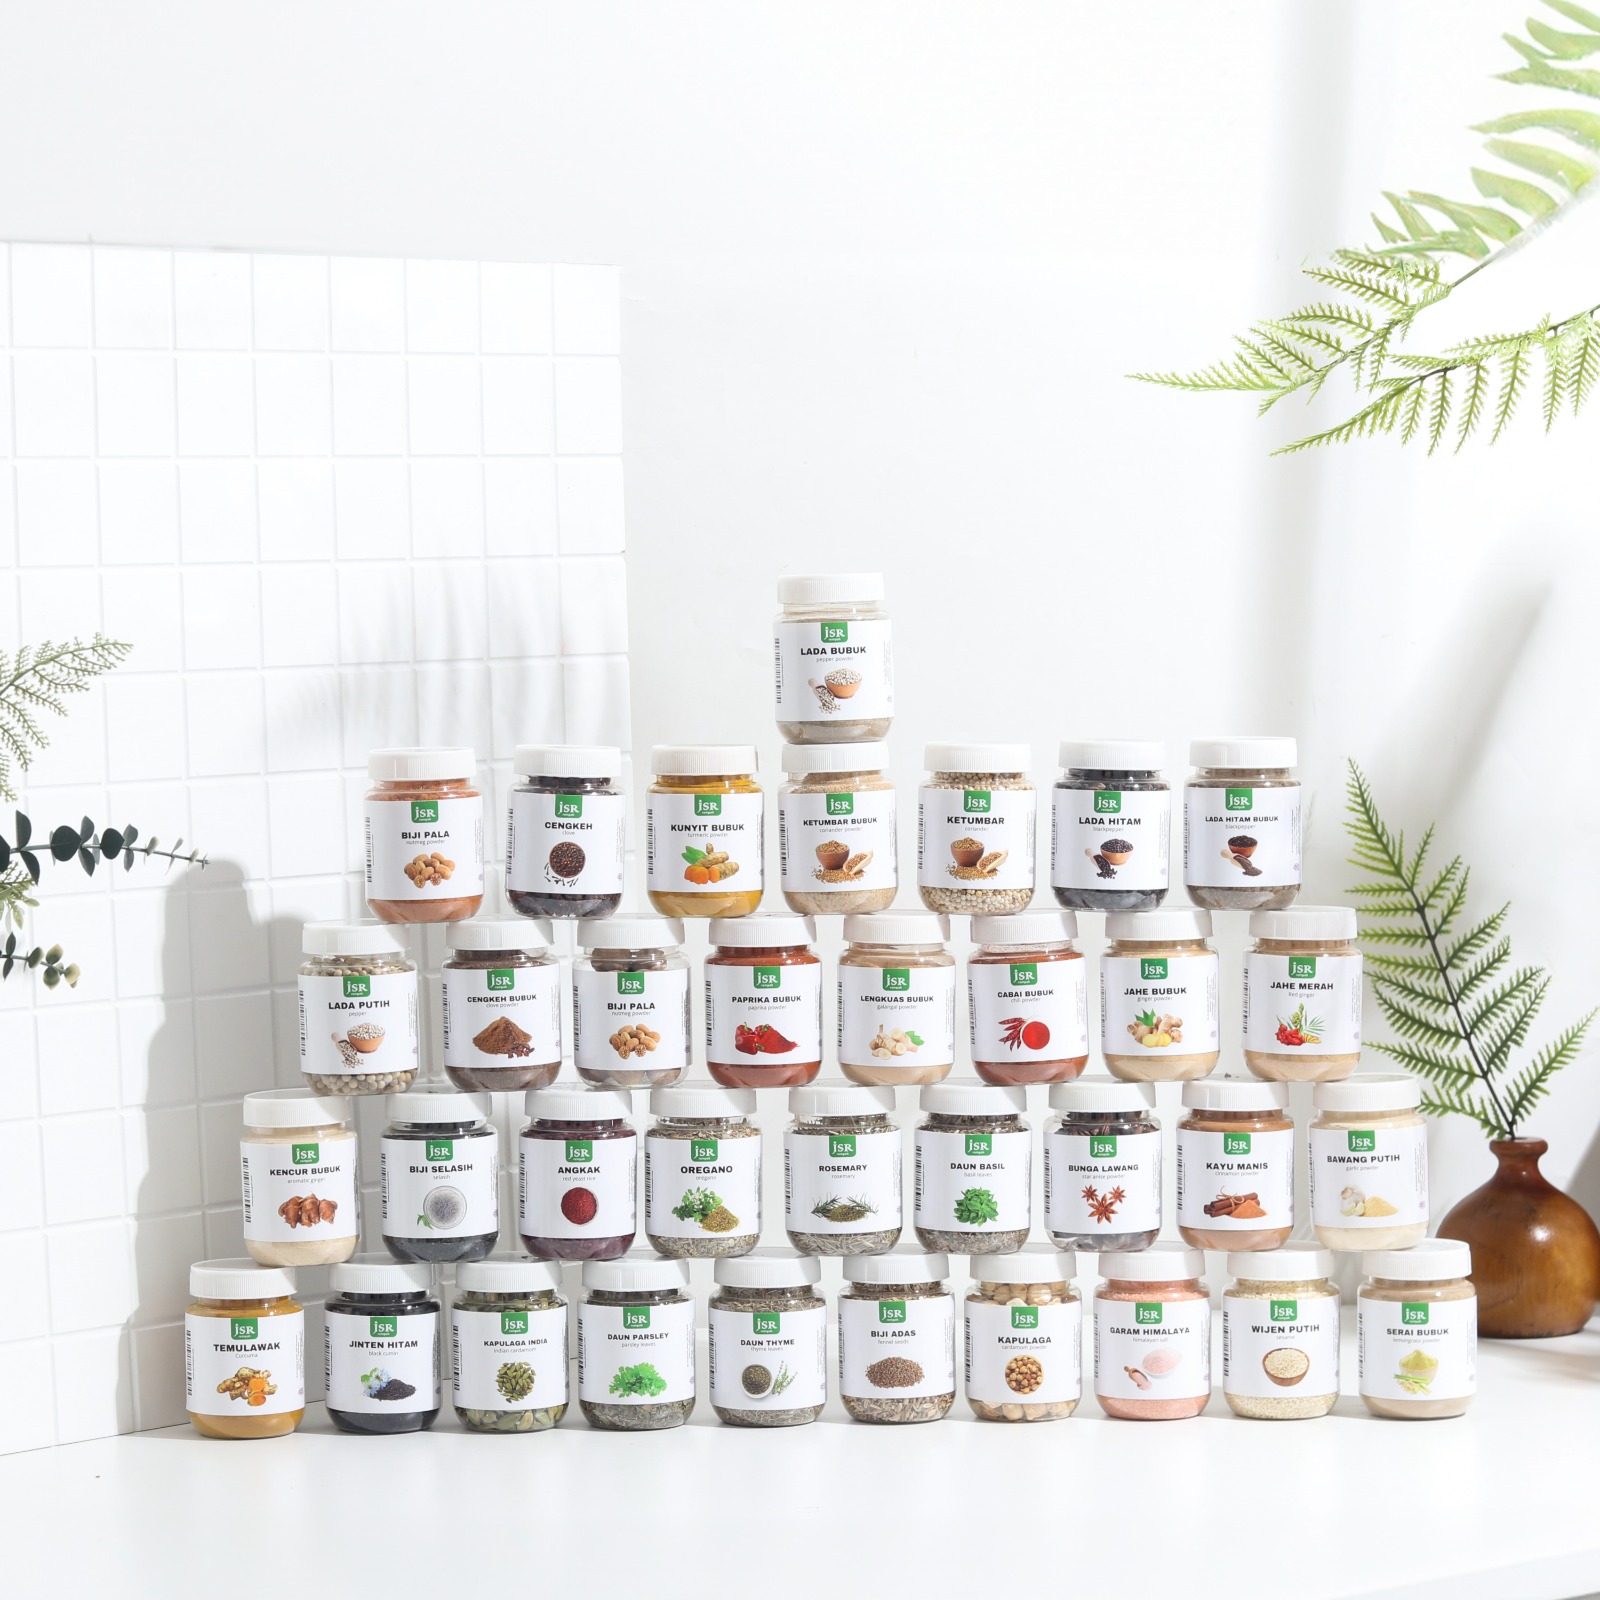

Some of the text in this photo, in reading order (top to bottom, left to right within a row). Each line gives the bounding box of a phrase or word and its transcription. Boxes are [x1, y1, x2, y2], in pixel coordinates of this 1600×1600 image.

[800, 646, 866, 656] LADA BUBUK
[947, 816, 1004, 825] KETUMBAR
[1079, 817, 1104, 825] LADA
[1270, 982, 1296, 990] JAHE
[359, 1000, 390, 1009] PUTIH
[311, 1166, 341, 1174] BUBUK
[431, 1164, 473, 1173] SELASIH
[681, 1166, 733, 1174] OREGANO
[1251, 1324, 1320, 1334] WIJEN PUTIH
[213, 1342, 280, 1352] TEMULAWAK
[349, 1340, 384, 1349] JINTEN
